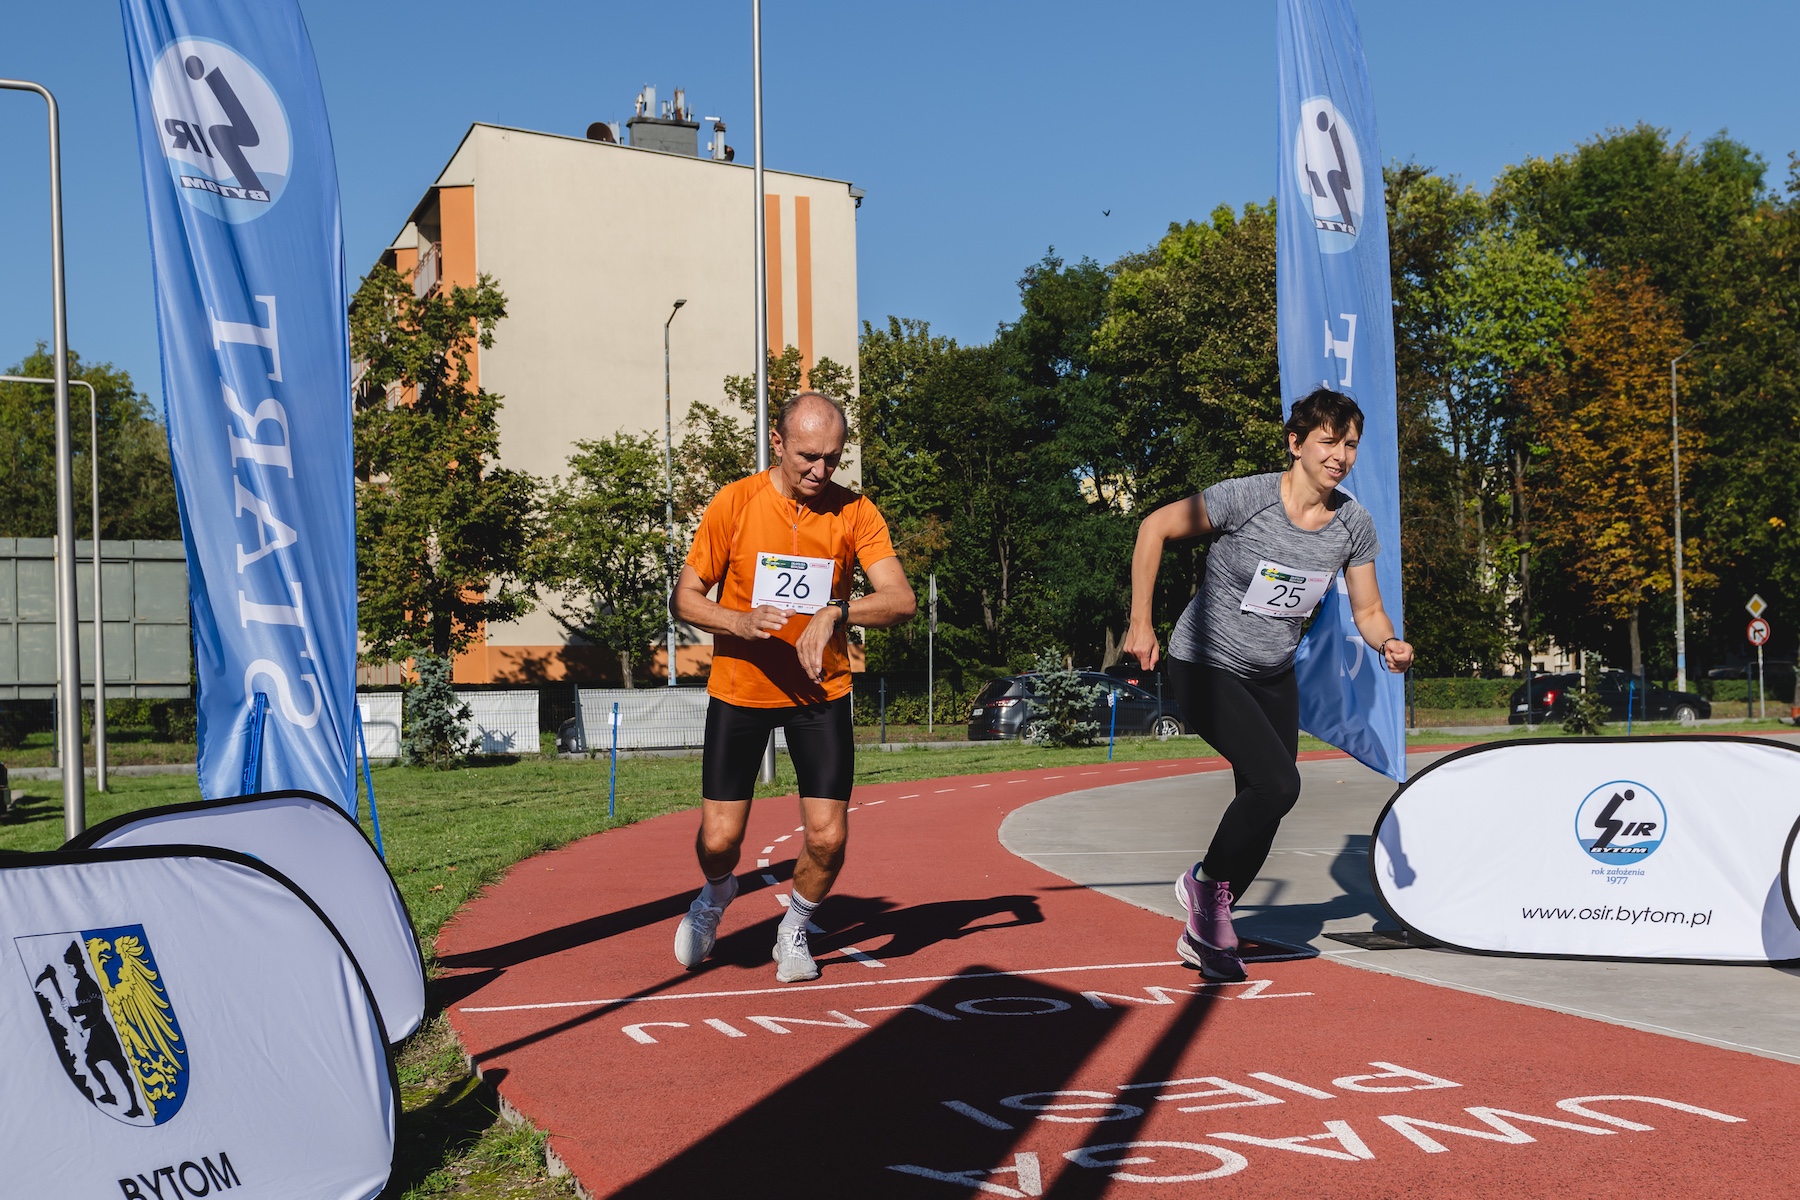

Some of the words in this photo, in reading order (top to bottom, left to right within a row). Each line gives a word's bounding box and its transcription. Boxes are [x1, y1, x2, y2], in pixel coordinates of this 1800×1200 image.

[775, 572, 810, 599] 26
[1266, 584, 1306, 609] 25
[1606, 868, 1645, 876] założenia
[1606, 876, 1628, 884] 1977
[1522, 905, 1712, 928] www.osir.bytom.pl
[620, 978, 1315, 1045] ZWOLNIJ
[940, 1060, 1463, 1132] PIESI
[886, 1093, 1748, 1199] UWAGA
[118, 1152, 242, 1200] BYTOM
